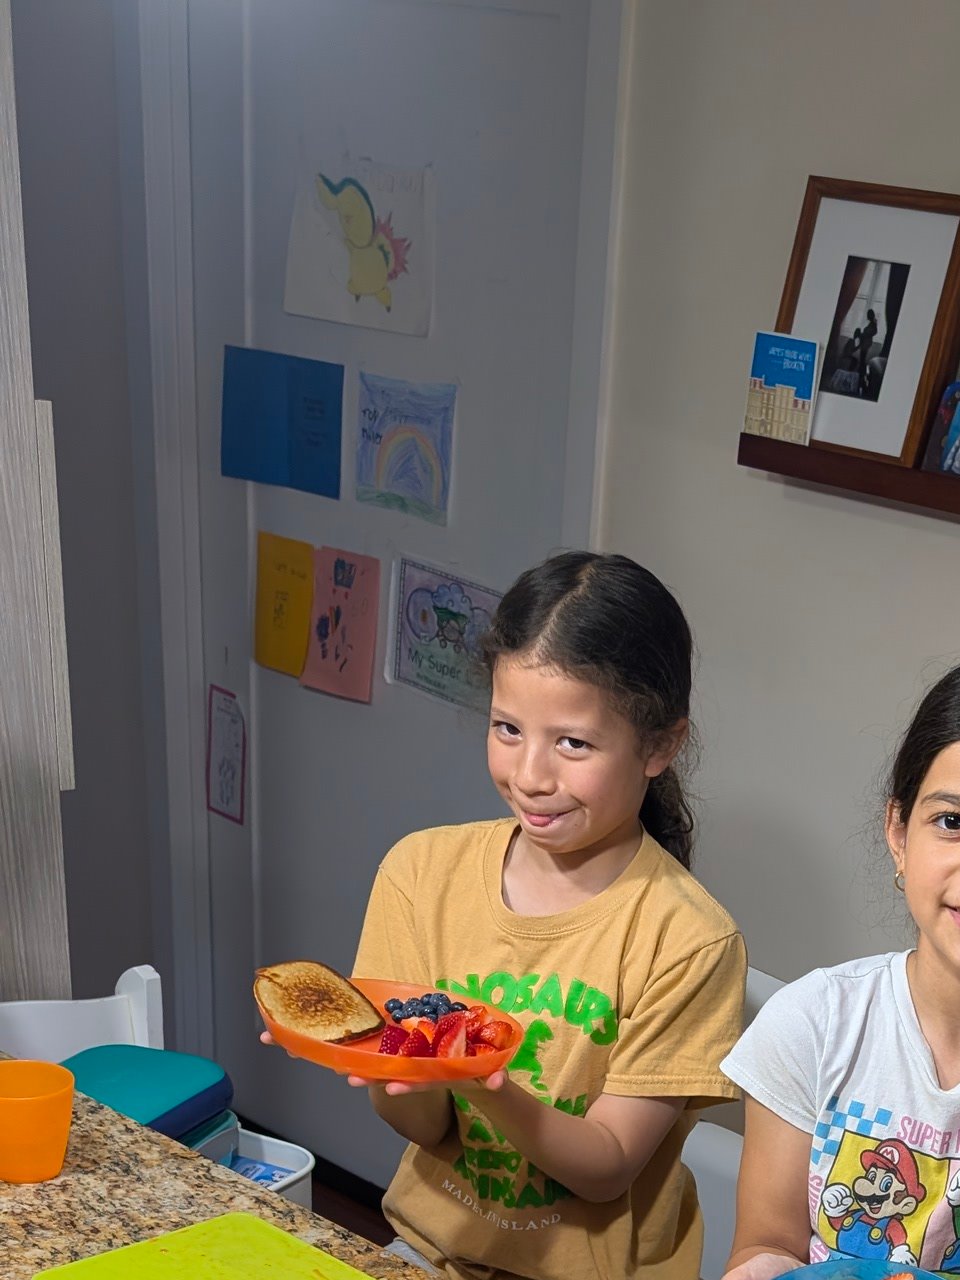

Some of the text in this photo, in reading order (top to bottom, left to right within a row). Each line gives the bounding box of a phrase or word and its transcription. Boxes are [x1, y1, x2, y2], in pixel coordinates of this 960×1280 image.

[407, 648, 424, 669] My
[428, 655, 462, 681] Super
[435, 970, 619, 1047] NOSAURS
[897, 1115, 951, 1154] SUPER
